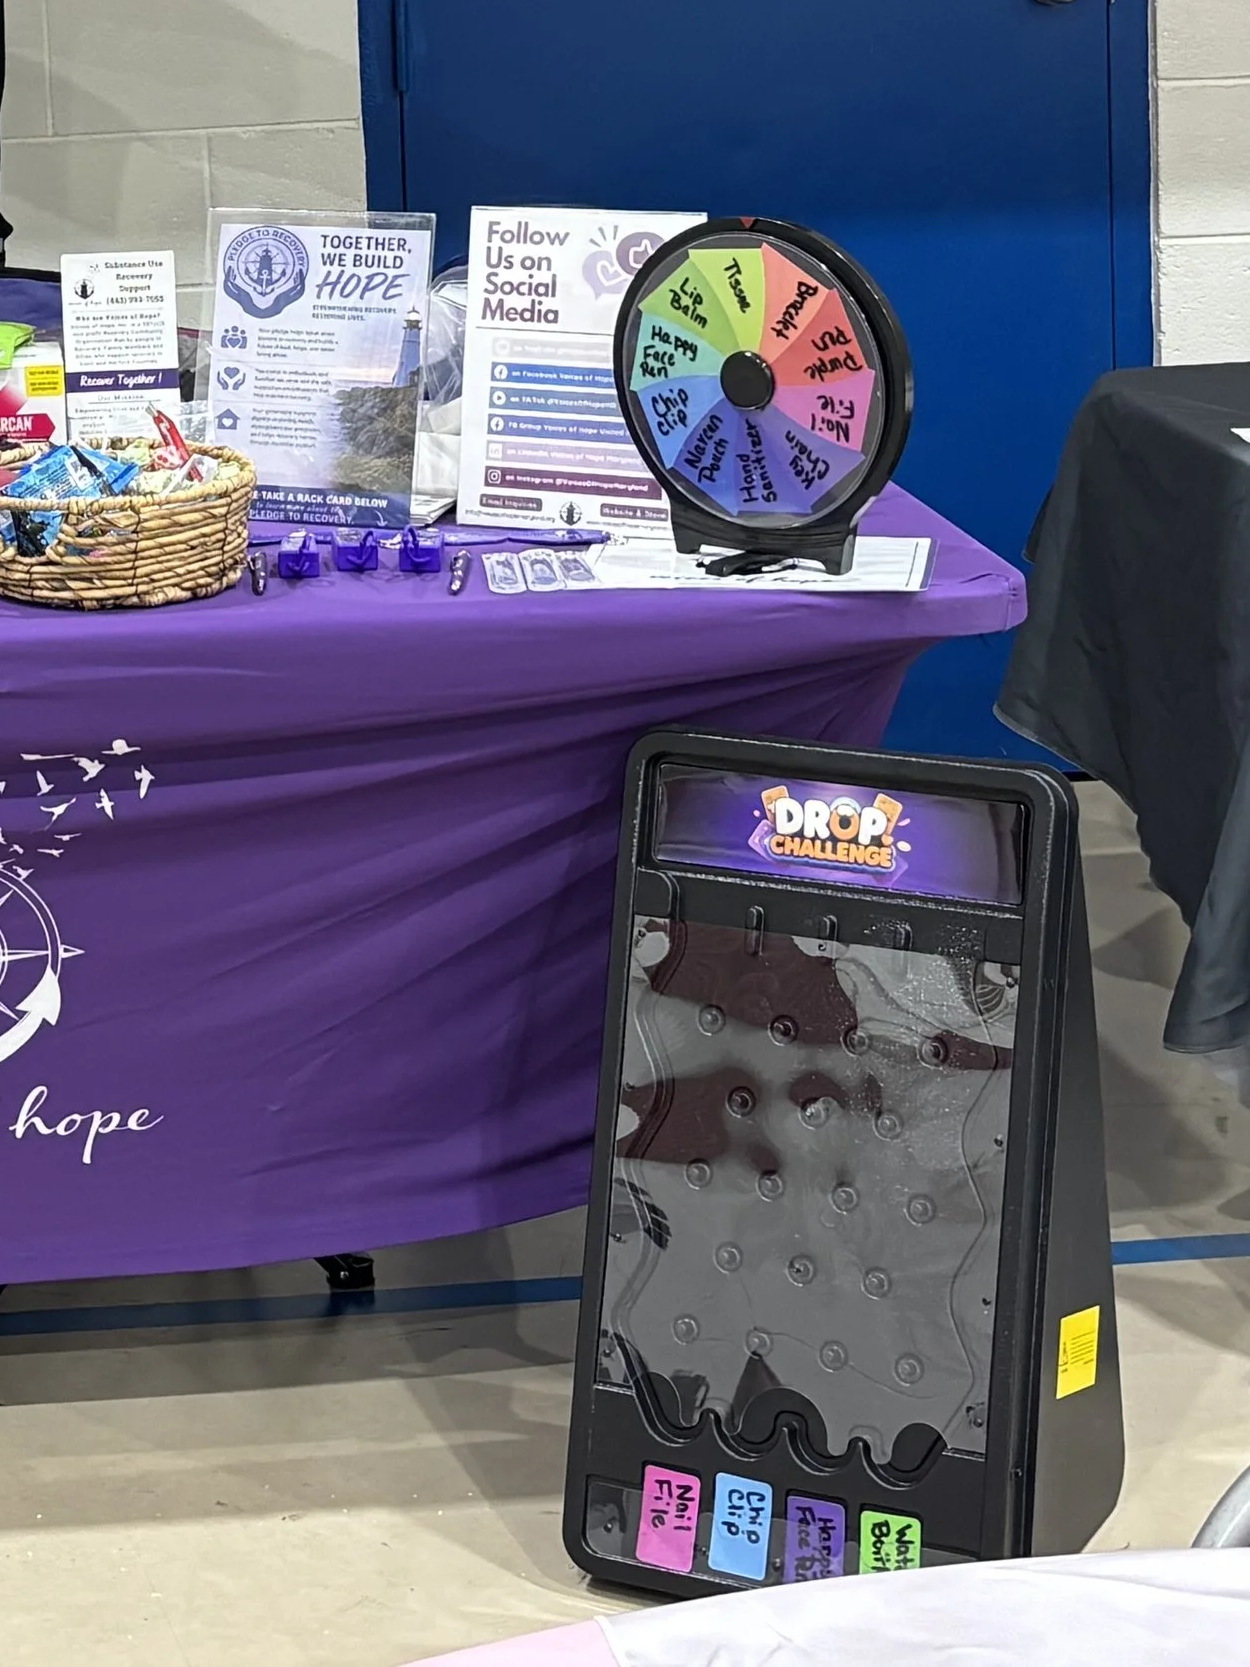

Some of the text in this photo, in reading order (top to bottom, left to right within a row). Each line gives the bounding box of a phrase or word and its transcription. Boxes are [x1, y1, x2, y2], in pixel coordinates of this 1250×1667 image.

[256, 229, 270, 237] TO
[272, 230, 306, 267] RECOVERY
[320, 234, 412, 254] TOGETHER,
[487, 220, 570, 246] Follow
[104, 261, 146, 269] Substance
[321, 253, 404, 269] WE BUILD
[485, 246, 552, 272] Us on
[116, 273, 153, 281] Recovery
[119, 285, 151, 293] Support
[315, 270, 410, 302] HOPE
[483, 271, 557, 298] Social
[680, 277, 704, 307] Lip
[481, 297, 559, 324] Media
[669, 288, 708, 329] Balm
[771, 281, 818, 340] Bracelet
[651, 325, 698, 362] Happy
[812, 326, 852, 352] Pen
[640, 362, 668, 379] Pen
[643, 345, 676, 367] Face
[803, 351, 863, 382] Purple
[79, 373, 156, 388] Recover Together
[651, 388, 689, 418] Chip
[817, 395, 855, 419] File
[811, 415, 850, 443] Nail
[698, 438, 728, 483] Pouch
[746, 418, 777, 503] Sanitizer
[785, 429, 830, 480] Chain
[736, 454, 759, 503] Hand
[789, 457, 816, 490] Key
[261, 491, 285, 501] TAKE
[287, 492, 296, 502] A
[297, 493, 324, 504] RACK
[326, 494, 352, 506] CARD
[354, 497, 388, 508] BELOW
[249, 509, 285, 521] PLEDGE
[288, 511, 301, 521] TO
[773, 797, 889, 847] DROP
[768, 836, 894, 868] CHALLENGE
[9, 1085, 164, 1165] hope
[651, 1478, 672, 1529] File
[676, 1483, 694, 1532] Nail
[746, 1491, 765, 1545] Chip
[797, 1506, 816, 1551] Face
